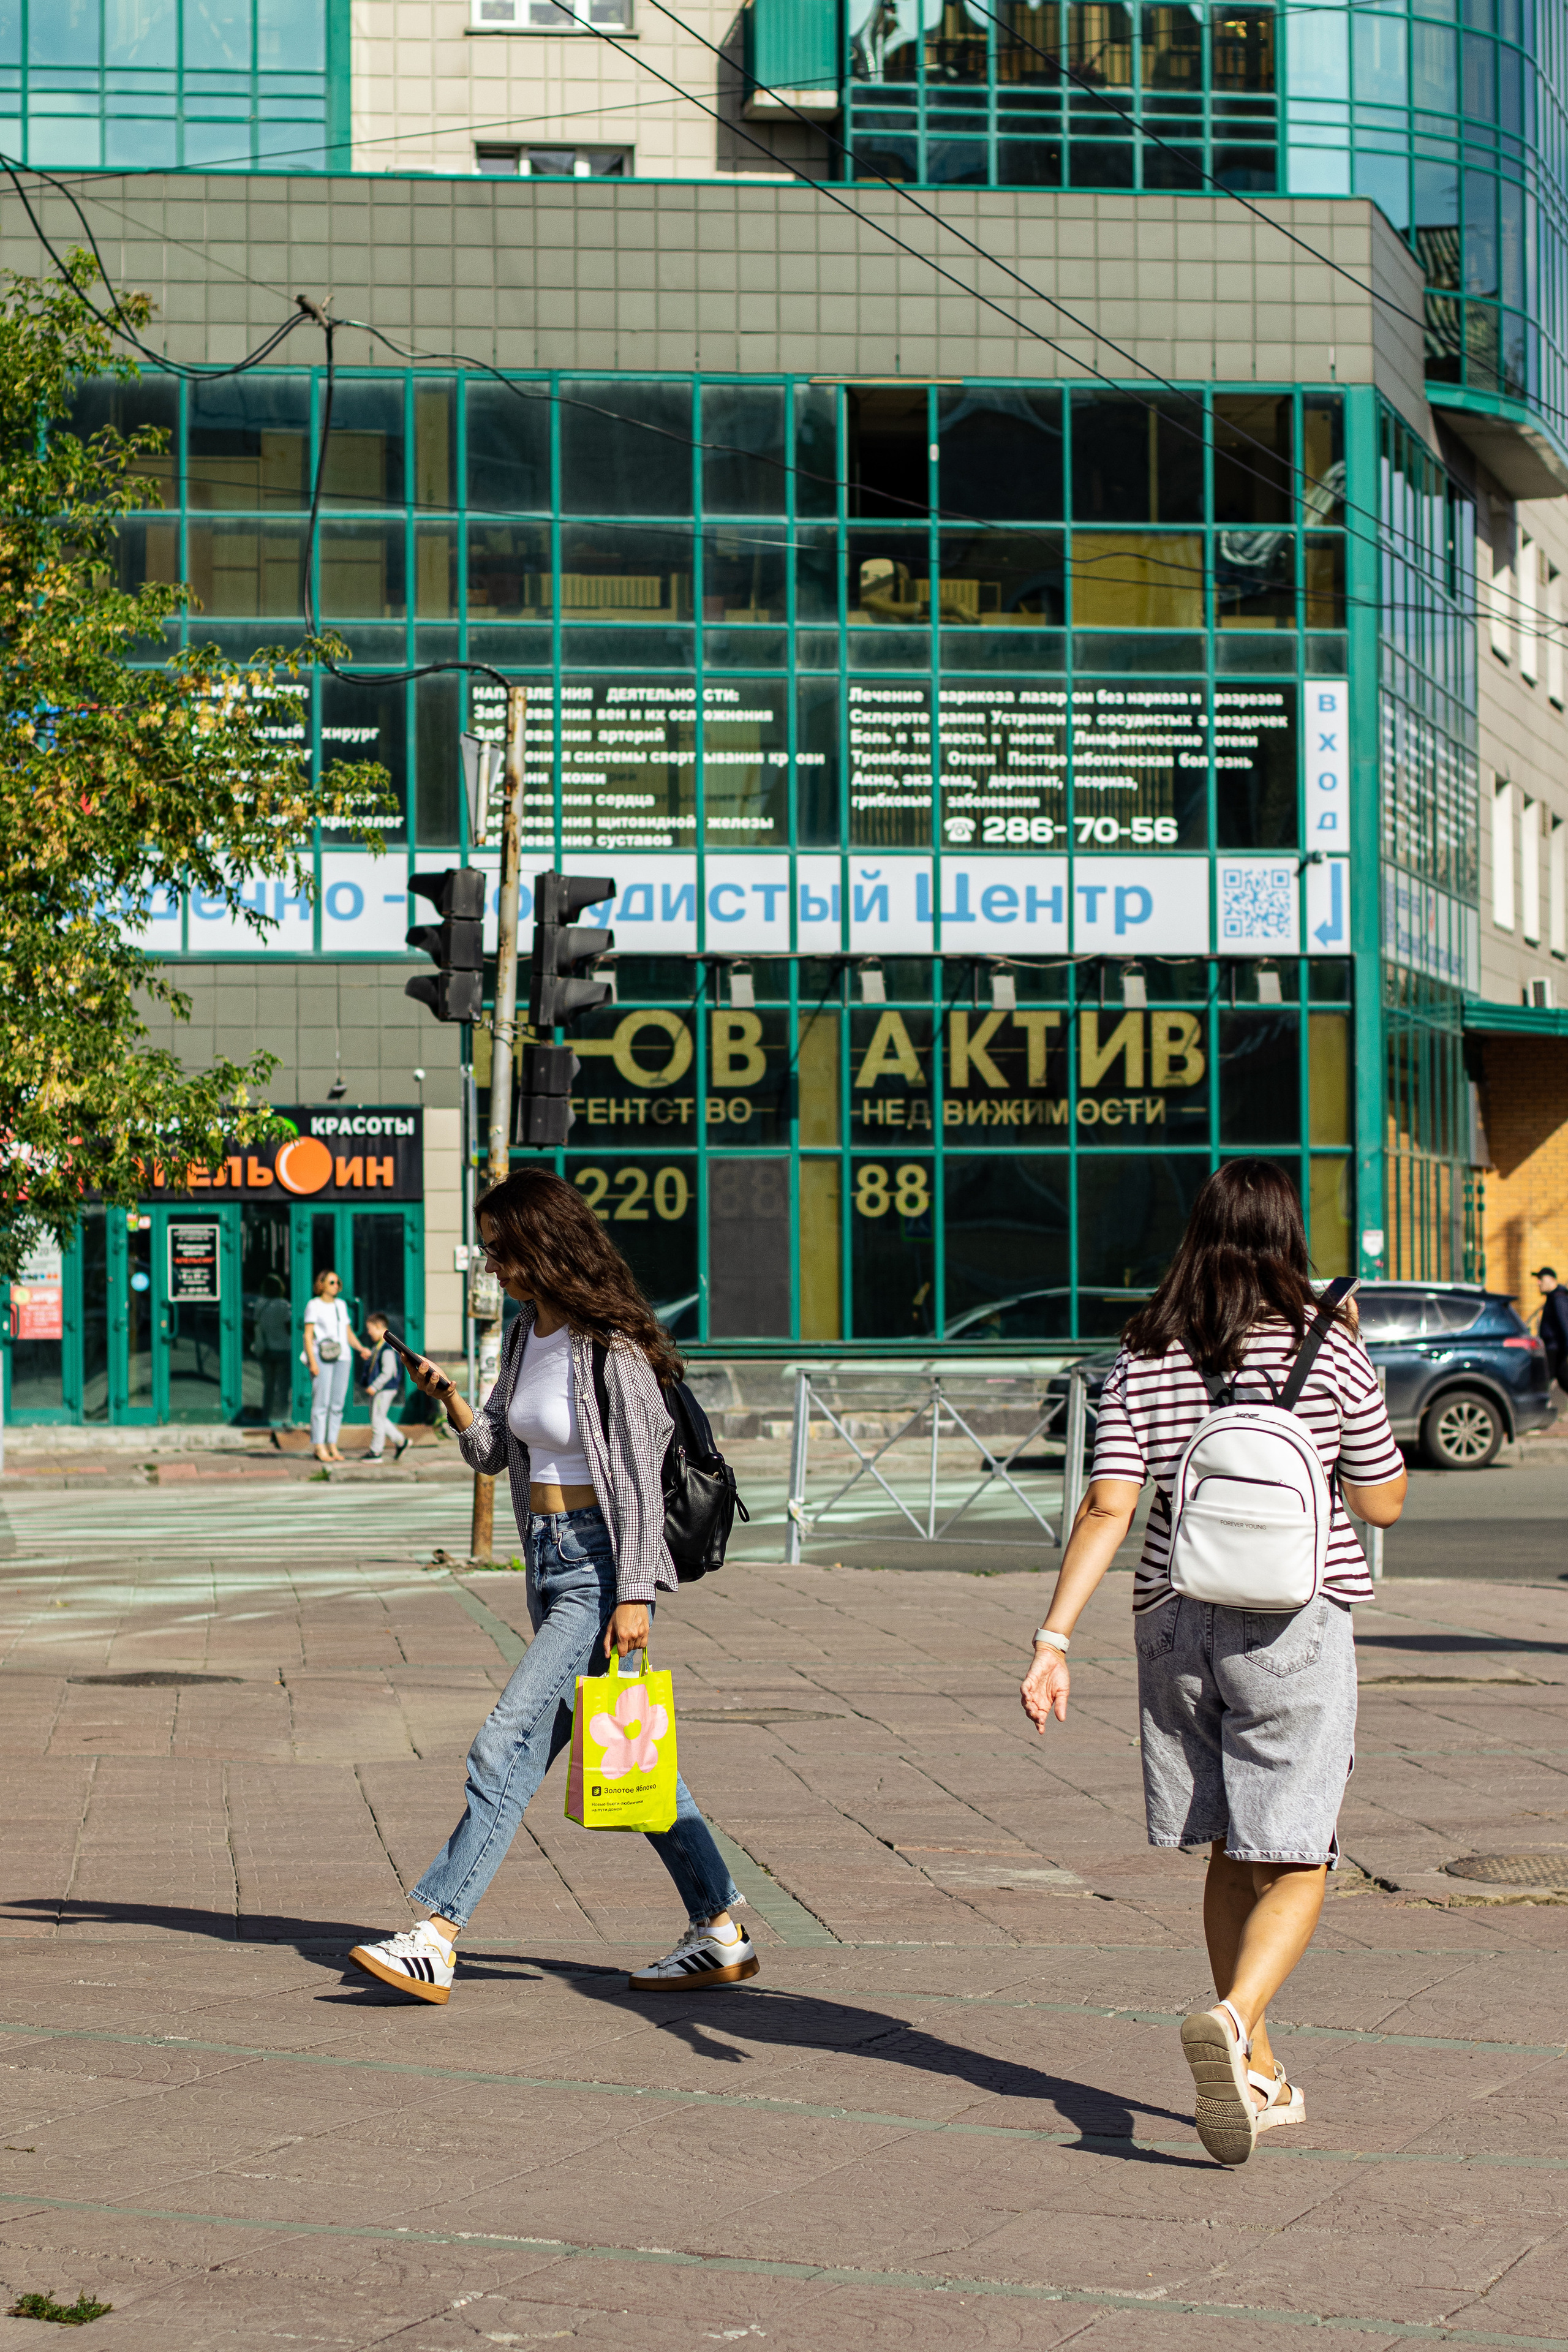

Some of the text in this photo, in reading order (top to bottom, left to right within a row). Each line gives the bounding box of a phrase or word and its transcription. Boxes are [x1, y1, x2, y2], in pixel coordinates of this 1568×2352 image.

[472, 686, 740, 703] НАПВЛЕНИЯ ДЕЯТЕЛЬНОСТИ:
[849, 687, 1284, 709] Лечение варикоза лазером без наркоза и разрезов
[473, 704, 774, 722] Забевания вен и их осложнения
[850, 708, 1289, 730] Склеротерапия Устранение сосудистых звездочек
[321, 727, 380, 743] хирург
[473, 725, 666, 745] Забевания артерий
[850, 728, 1259, 750] Боль и тяжесть в ногах Лимфатические отеки
[573, 751, 647, 764] системы
[649, 751, 764, 766] свертывания
[768, 752, 826, 767] крови
[850, 748, 1254, 769] Тромбозы Отеки Посттромботическая болезнь
[560, 772, 607, 785] кожи
[851, 770, 1139, 791] Акне, экзема, дерматит, псориаз,
[595, 794, 656, 810] сердца
[851, 791, 1041, 812] грибковые заболевания
[596, 813, 697, 831] щитовидной
[706, 817, 774, 829] железы
[596, 834, 674, 850] суставов
[916, 872, 1154, 935] Центр
[854, 1010, 1206, 1088] АКТИВ
[567, 1096, 1167, 1130] ГЕНТСТВО НЕДВИЖИМОСТИ
[311, 1116, 415, 1136] КРАСОТЫ
[573, 1166, 688, 1221] 220
[856, 1164, 929, 1218] 88
[1220, 1520, 1244, 1528] FOREVER
